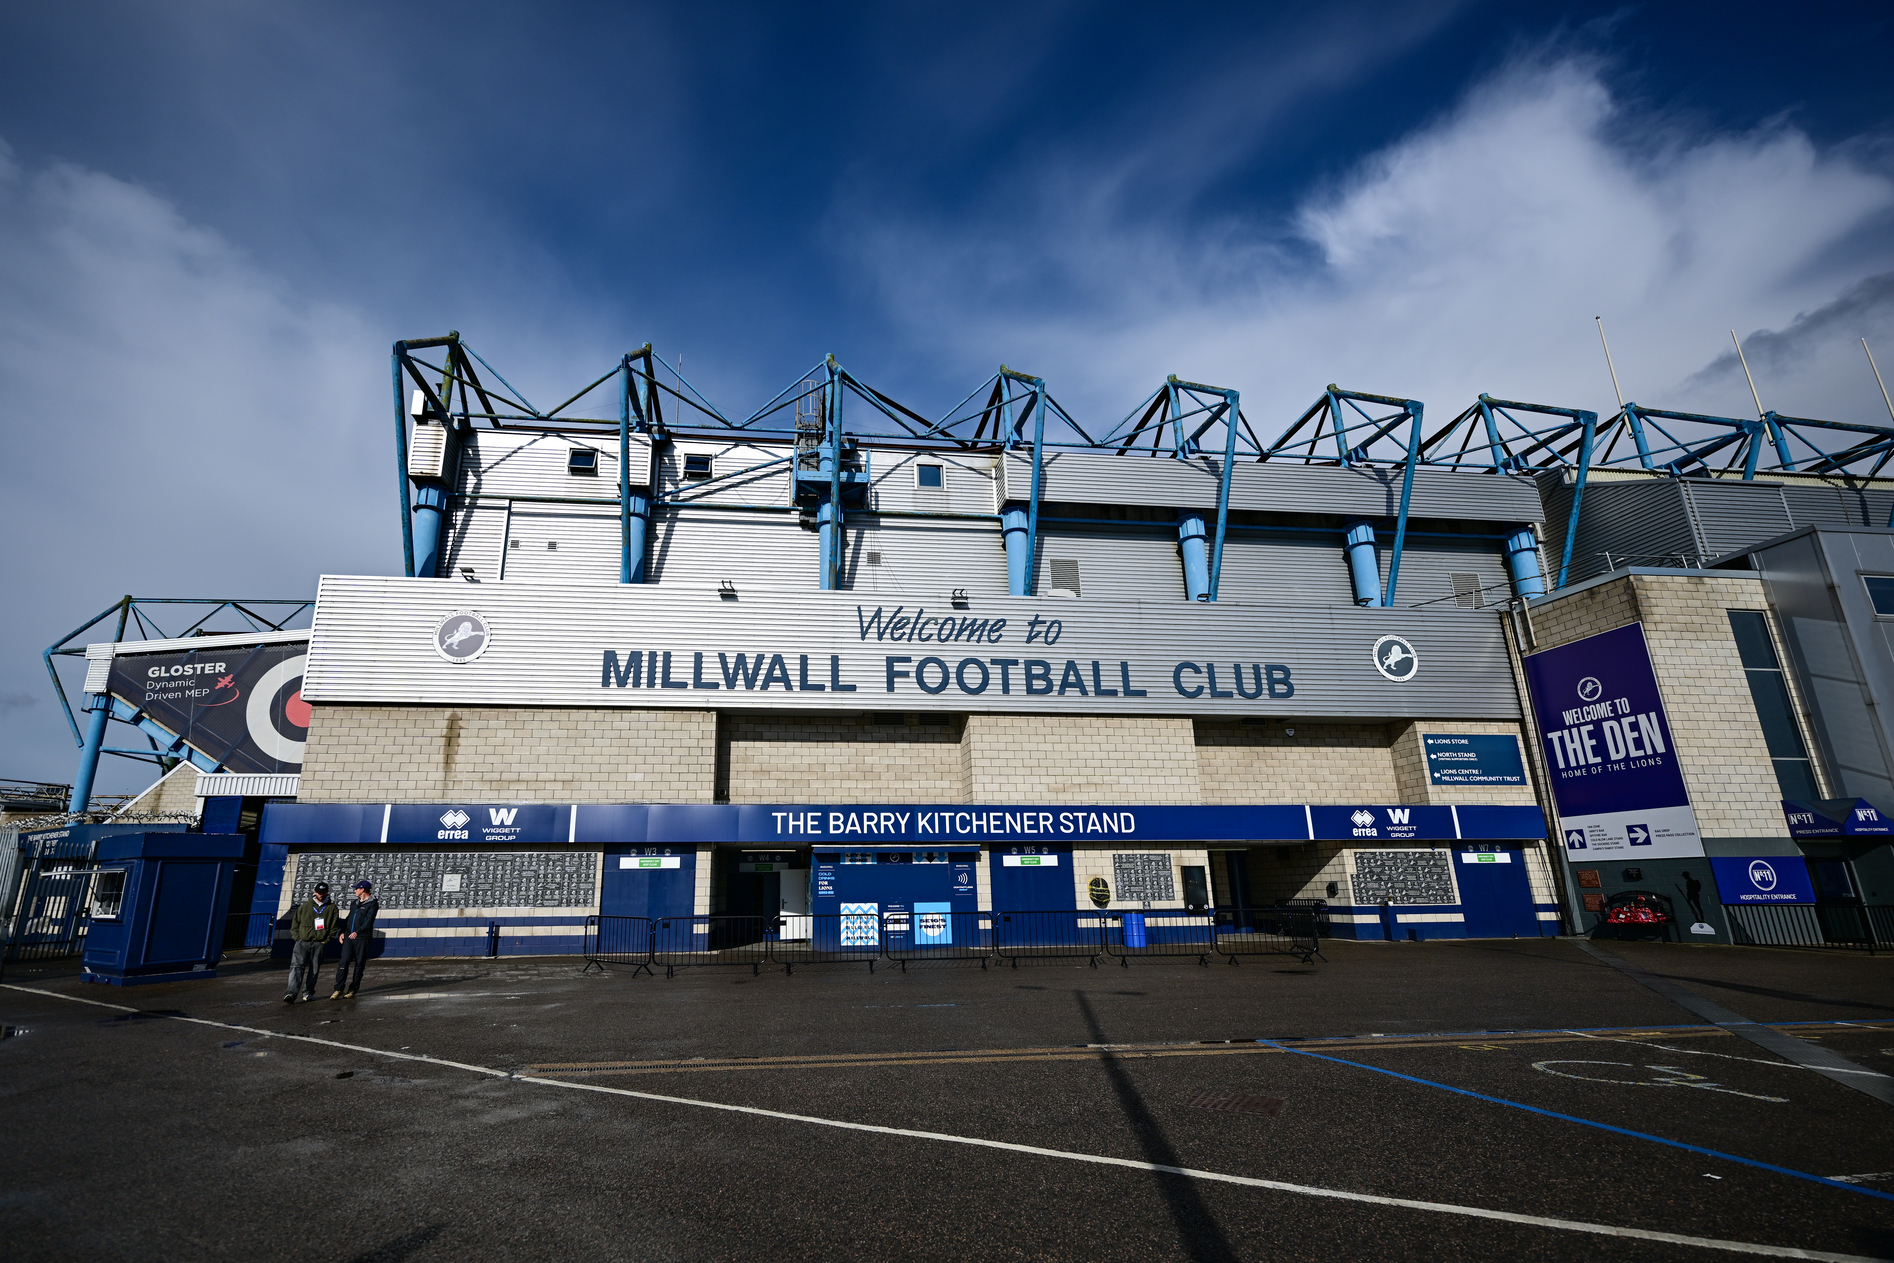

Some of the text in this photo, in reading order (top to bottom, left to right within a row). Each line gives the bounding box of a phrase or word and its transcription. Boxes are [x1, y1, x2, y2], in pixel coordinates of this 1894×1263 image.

[857, 605, 1062, 645] Welcome to
[148, 662, 226, 678] GLOSTER
[601, 650, 1295, 699] MILLWALL FOOTBALL CLUB
[146, 679, 195, 690] Dynamic
[145, 688, 210, 700] Driven MEP
[1562, 697, 1630, 726] WELCOME TO
[1547, 711, 1666, 769] THE DEN
[1561, 757, 1662, 778] HOME OF THE LIONS
[489, 808, 518, 825] W
[772, 812, 1136, 834] THE BARRY KITCHENER STAND
[1386, 808, 1410, 824] W
[437, 829, 469, 839] errea
[1352, 828, 1377, 836] errea
[644, 847, 657, 855] W3
[1024, 846, 1036, 854] W5
